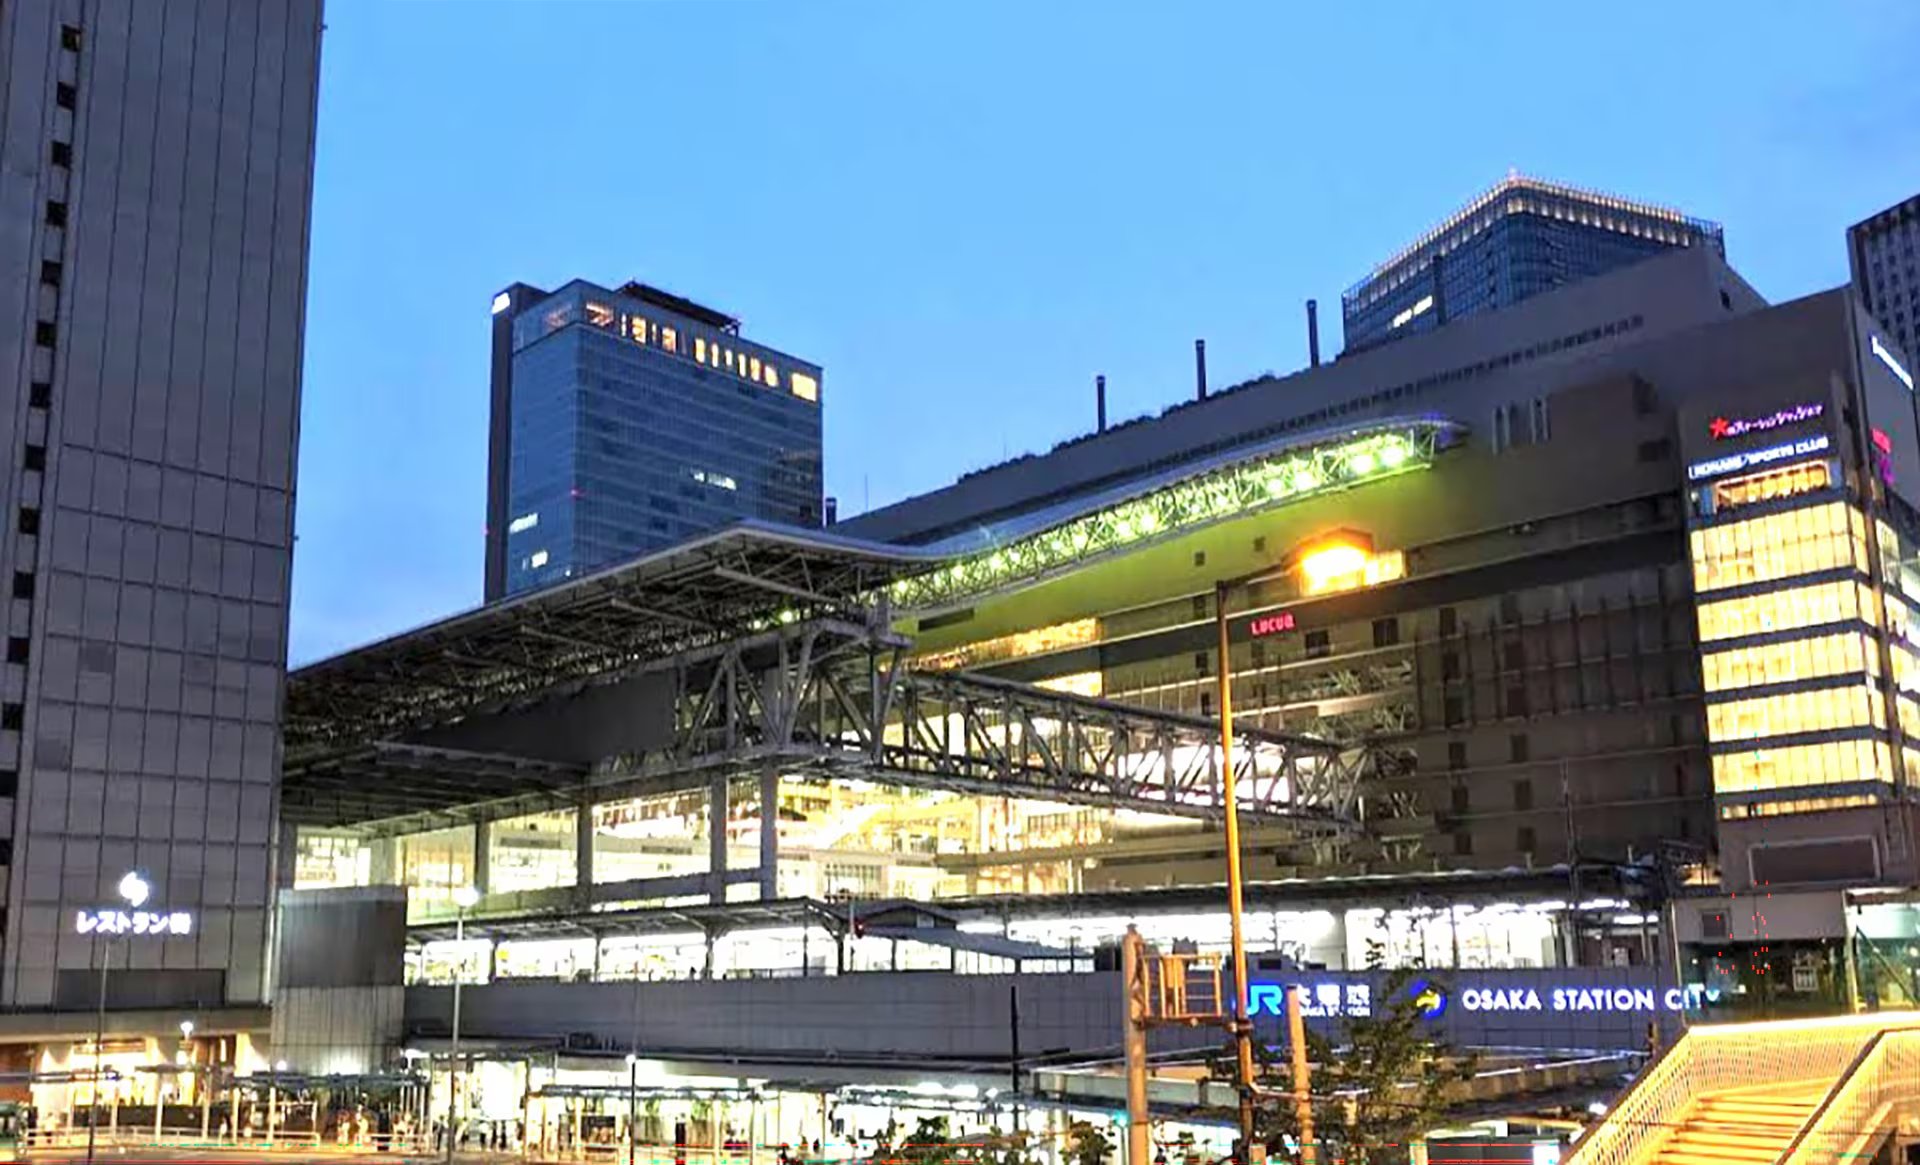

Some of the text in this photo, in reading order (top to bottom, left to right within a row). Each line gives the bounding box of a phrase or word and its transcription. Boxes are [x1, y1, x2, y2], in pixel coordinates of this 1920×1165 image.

[1247, 985, 1282, 1015] JR
[1462, 989, 1541, 1011] OSAKA
[1553, 989, 1655, 1011] STATION
